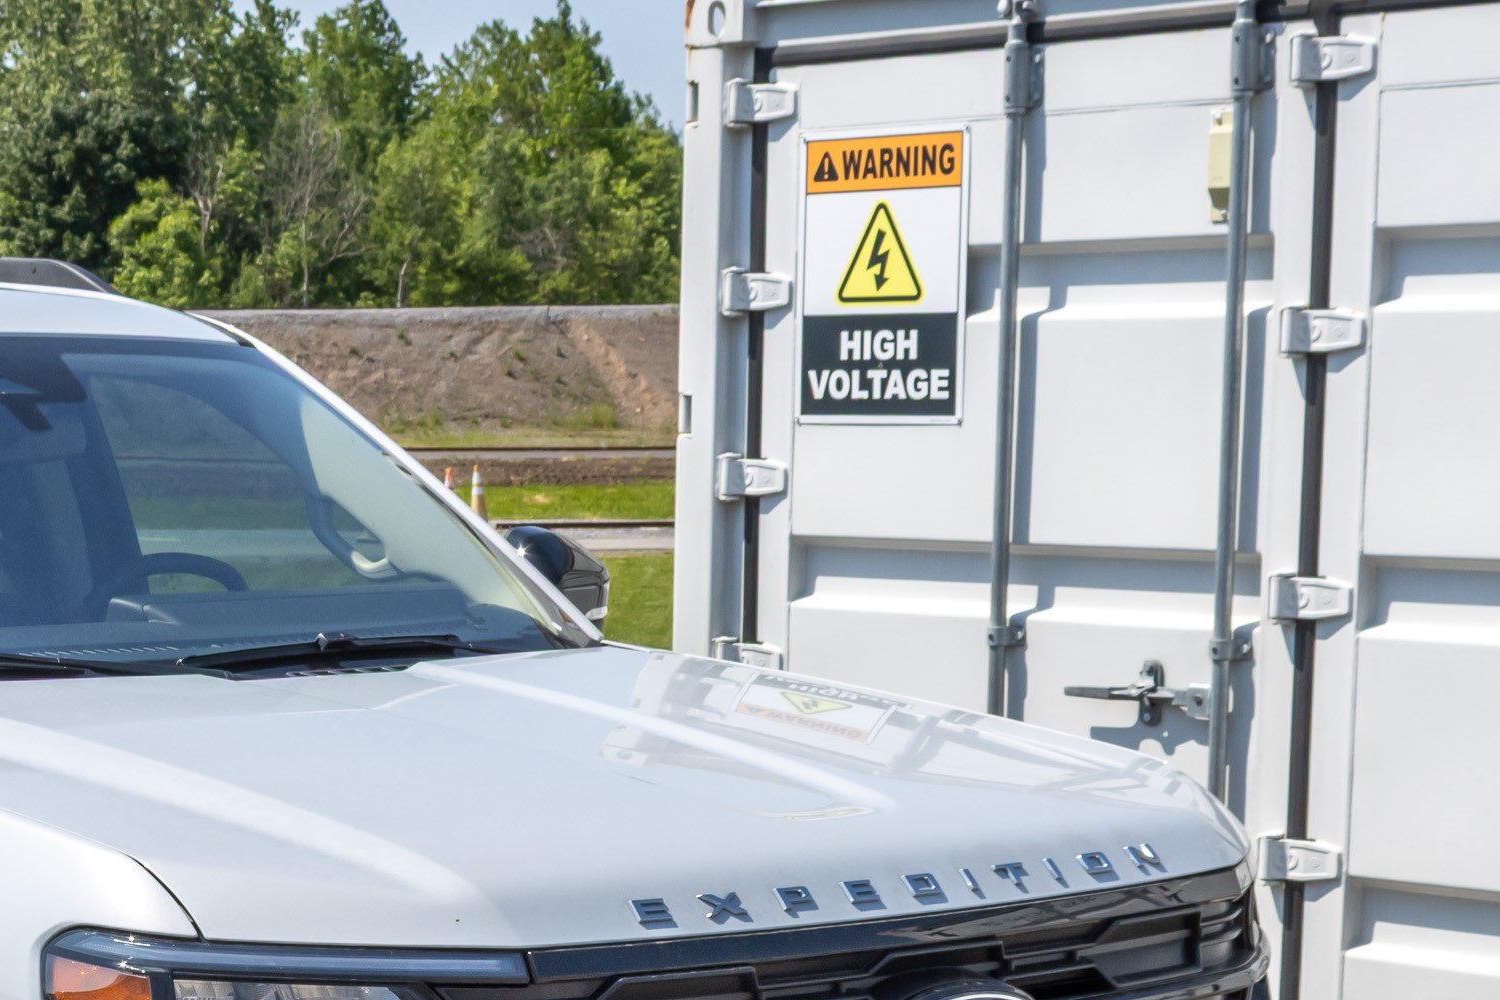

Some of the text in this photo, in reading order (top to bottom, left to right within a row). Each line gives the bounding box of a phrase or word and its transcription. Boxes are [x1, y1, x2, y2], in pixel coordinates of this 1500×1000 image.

[842, 143, 955, 181] WARNING
[839, 329, 918, 361] HIGH
[807, 368, 950, 400] VOLTAGE
[629, 843, 1160, 924] EXPEDITION
